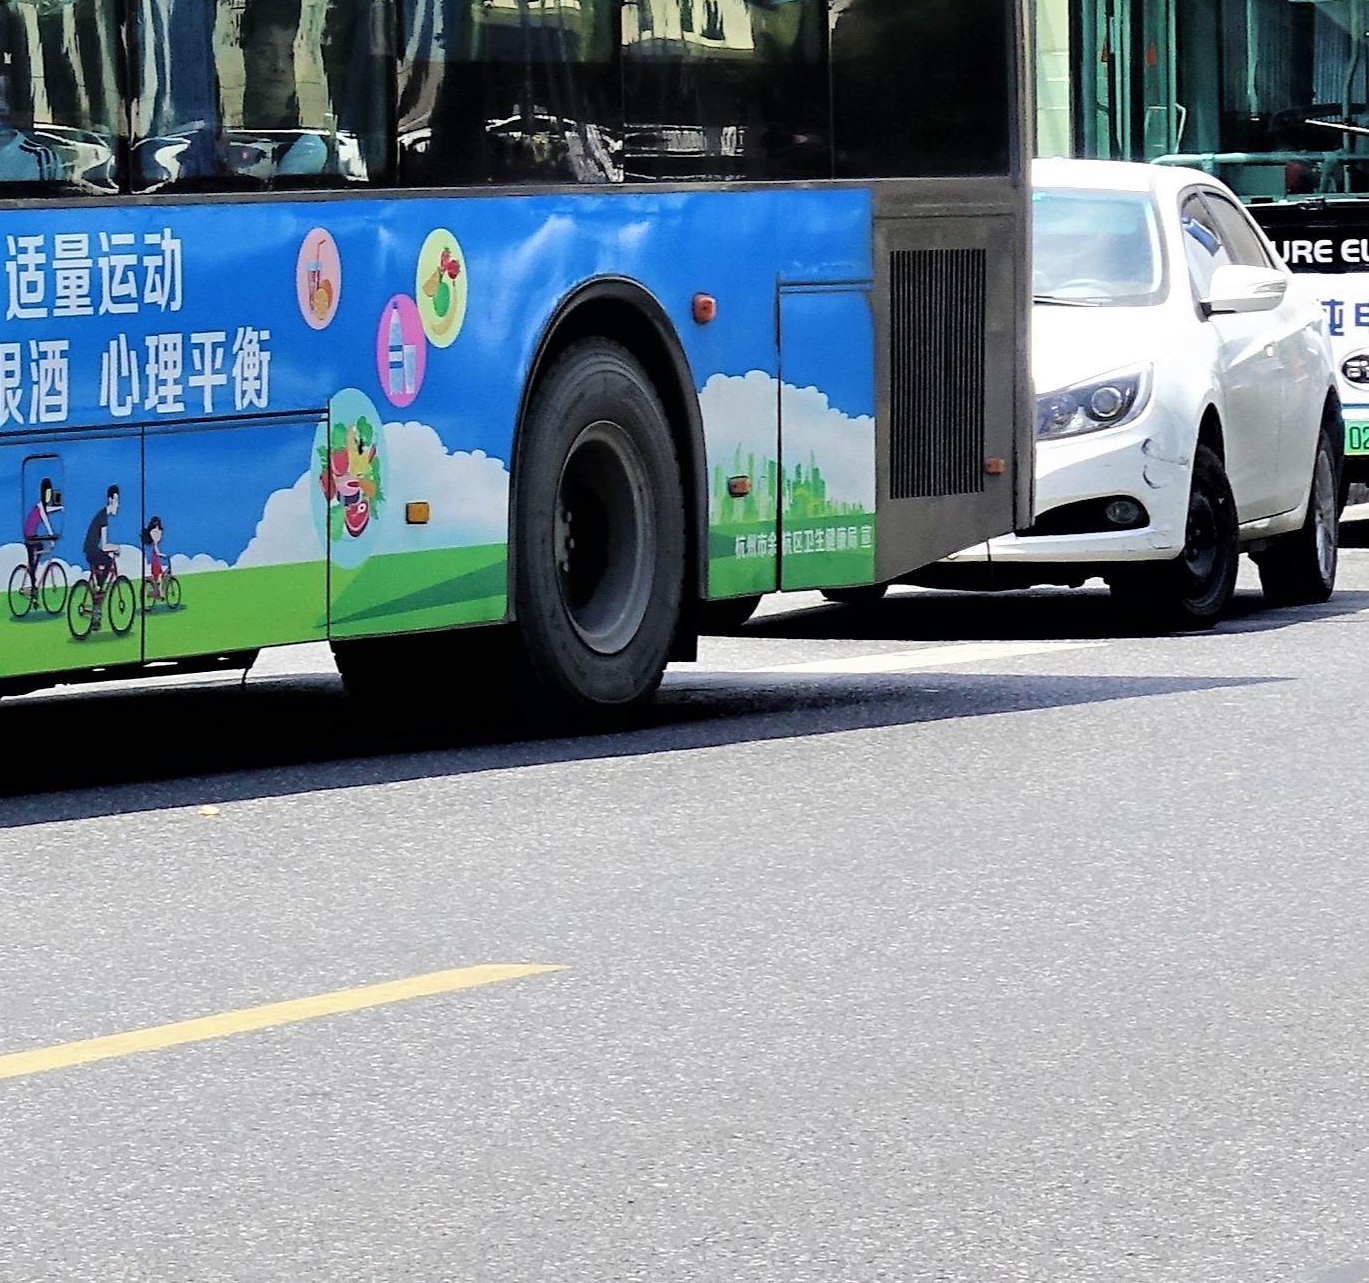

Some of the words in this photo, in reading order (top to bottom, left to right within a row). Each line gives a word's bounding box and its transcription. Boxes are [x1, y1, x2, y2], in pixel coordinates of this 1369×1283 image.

[5, 228, 183, 320] 适量运动
[98, 327, 271, 416] 心理平衡
